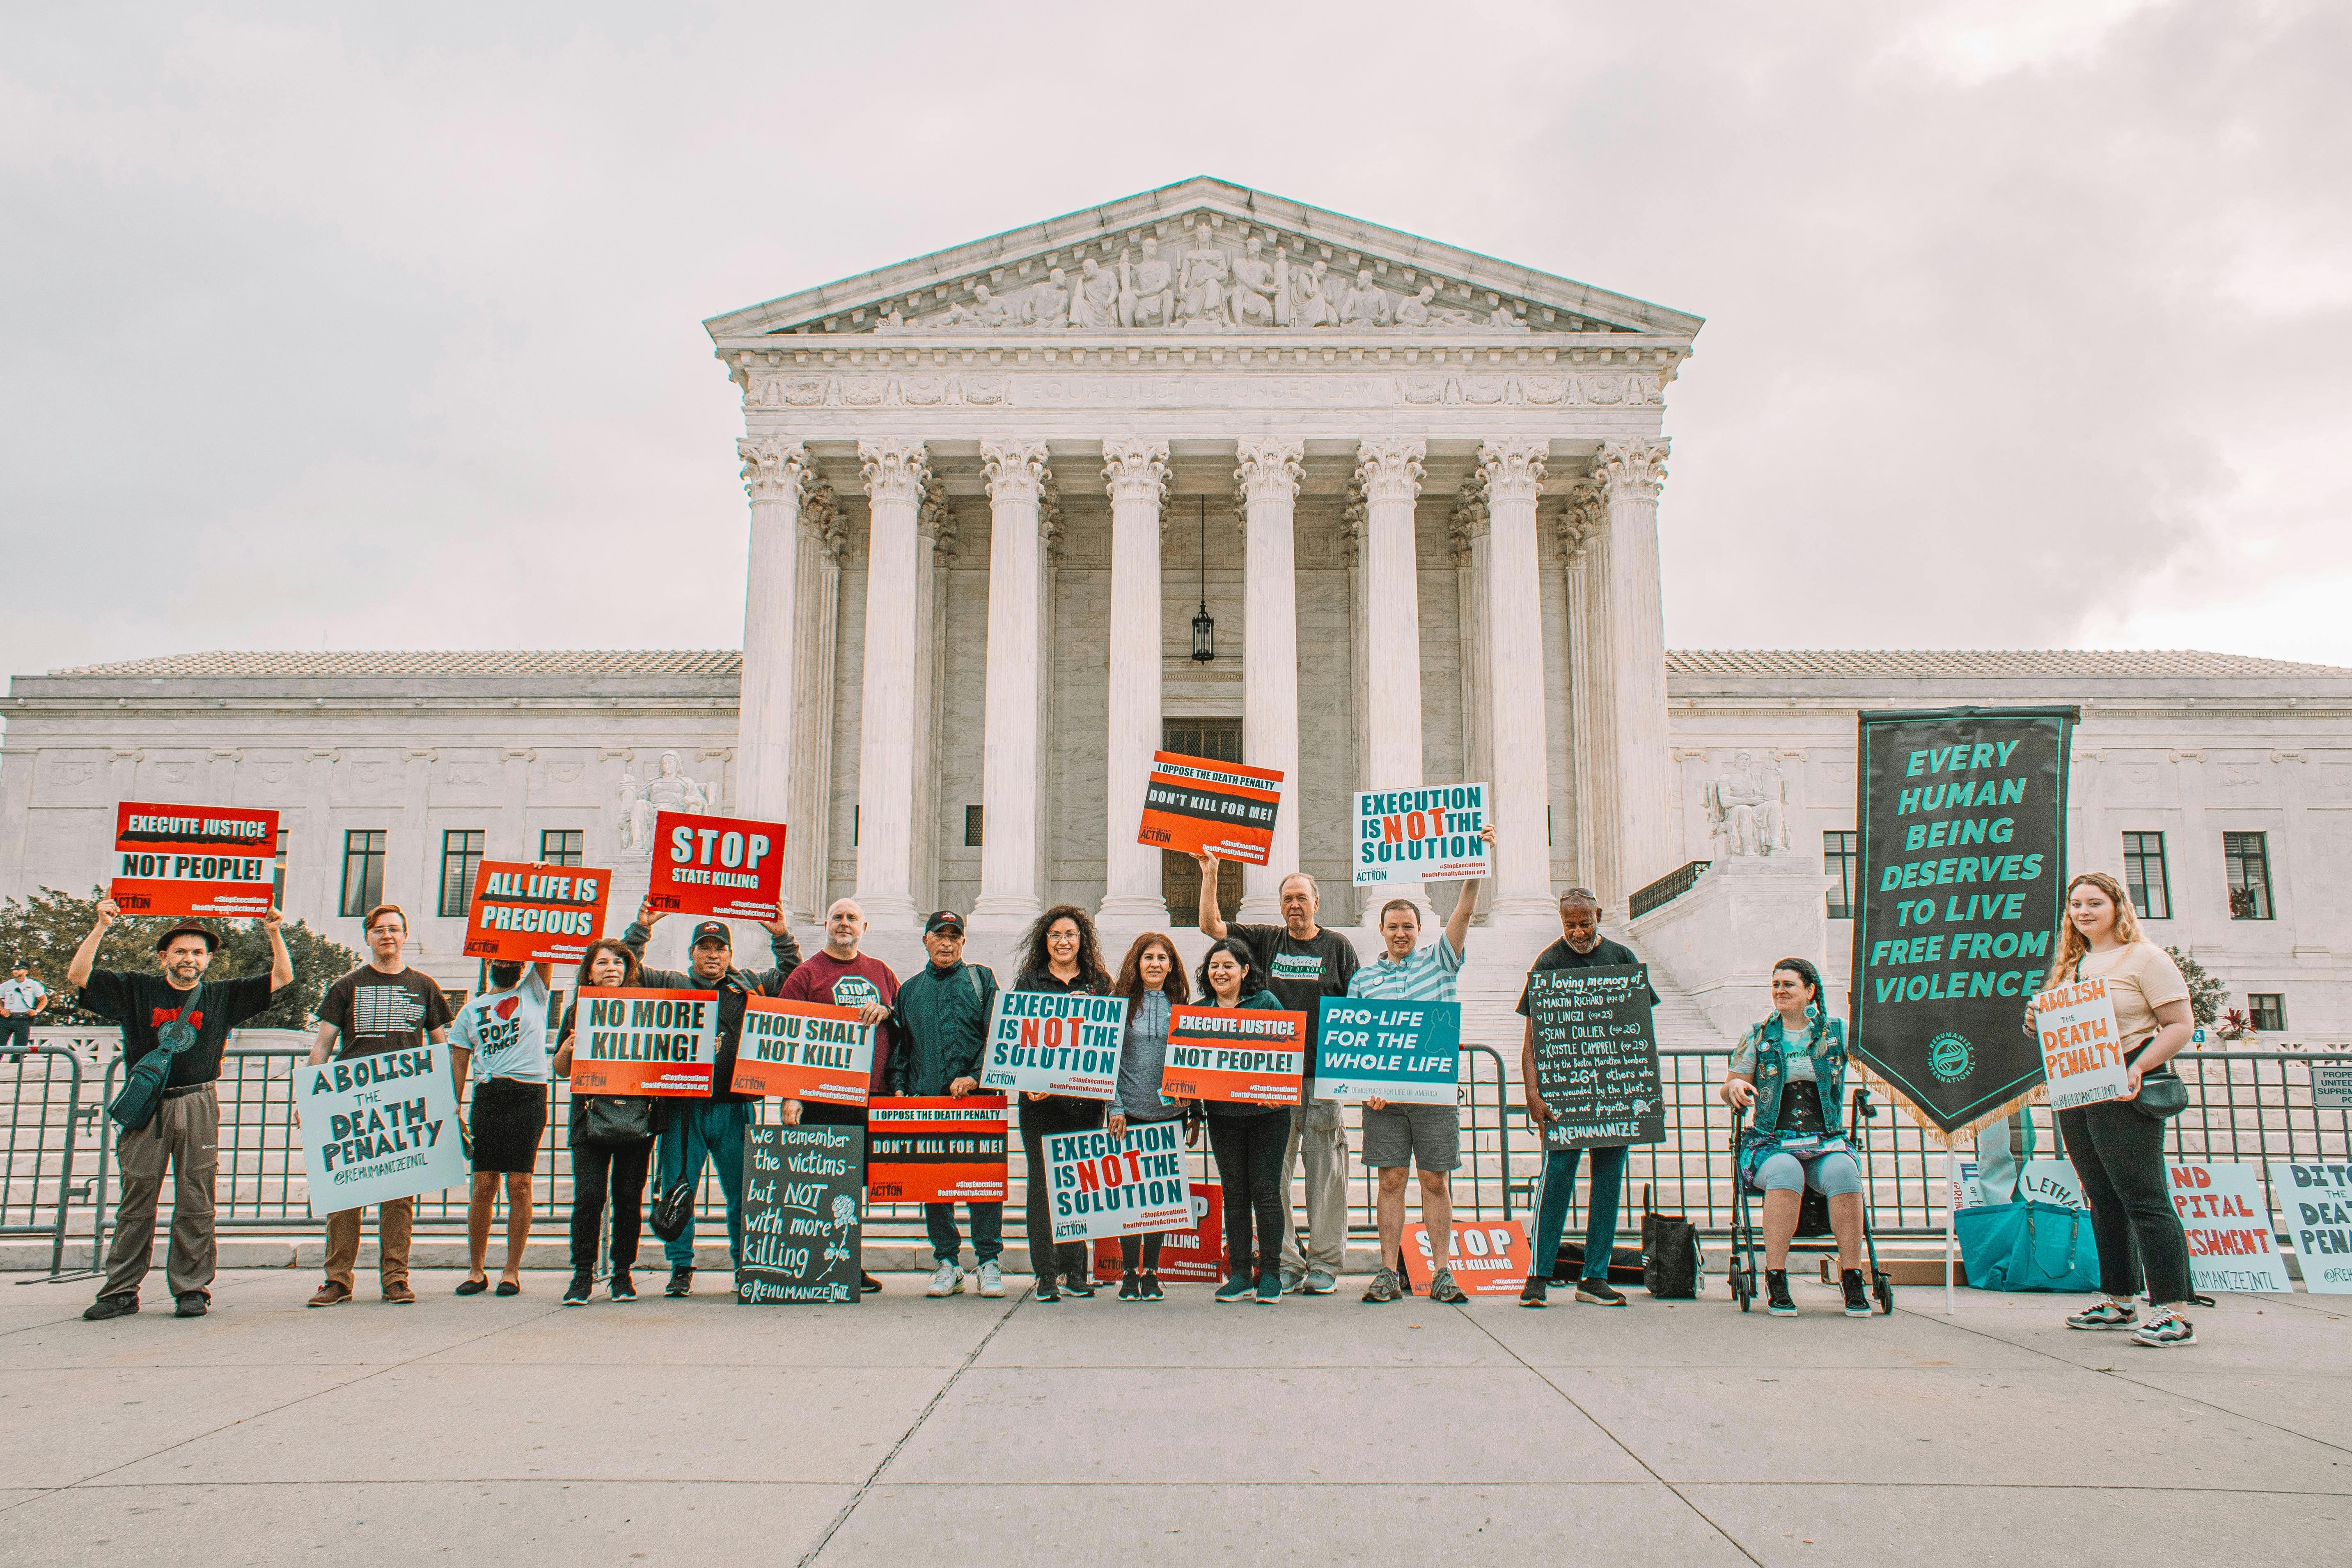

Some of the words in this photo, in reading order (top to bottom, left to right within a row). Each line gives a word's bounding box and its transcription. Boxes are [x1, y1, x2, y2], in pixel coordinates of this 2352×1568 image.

[1032, 381, 1119, 399] EQUAL
[1121, 380, 1220, 400] JUSTICE
[1235, 380, 1314, 399] UNDER
[1327, 381, 1375, 399] LAW
[1906, 740, 2020, 777] EVERY
[1162, 764, 1194, 777] OPPOSE
[1196, 770, 1210, 779] THE
[1213, 773, 1238, 784] DEATH
[1240, 777, 1275, 790] PENALTY
[1149, 789, 1187, 806] DON'T
[1190, 796, 1216, 812] KILL
[1221, 802, 1245, 816] FOR
[1249, 806, 1272, 821] ME!
[1362, 787, 1481, 816] EXECUTION
[1898, 778, 2027, 816] HUMAN
[129, 815, 200, 834] EXECUTE
[202, 819, 266, 838] JUSTICE
[1362, 819, 1380, 839] IS
[1383, 808, 1445, 844] NOT
[1445, 812, 1482, 832] THE
[1905, 817, 2014, 851] BEING
[671, 826, 770, 869] STOP
[1202, 844, 1264, 860] DeathPenaltyAction.org
[1221, 840, 1265, 852] #StopExecutions
[1362, 835, 1482, 863] SOLUTION
[123, 854, 171, 878] NOT
[174, 856, 263, 881] PEOPLE!
[672, 868, 711, 885] STATE
[712, 871, 759, 889] KILLING
[1422, 869, 1485, 878] DeathPenaltyAction.org
[1880, 854, 2044, 892] DESERVES
[485, 872, 523, 896] ALL
[527, 875, 571, 900] LIFE
[573, 878, 598, 901] IS
[481, 905, 593, 935] PRECIOUS
[1896, 898, 1936, 927] TO
[1944, 893, 2027, 922] LIVE
[1870, 935, 1944, 966] FREE
[1949, 931, 2049, 960] FROM
[839, 983, 871, 995] STOP
[1532, 974, 1547, 989] In
[1552, 972, 1584, 994] loving
[1587, 976, 1628, 988] memory
[1630, 971, 1643, 984] of
[1875, 970, 2045, 1004] VIOLENCE
[838, 995, 877, 1004] EXECUTIONS
[1002, 993, 1122, 1023] EXECUTION
[1543, 998, 1571, 1008] MARTIN
[1574, 995, 1603, 1007] RICHARD
[1606, 995, 1617, 1003] (age
[1618, 993, 1625, 1002] 8)
[2038, 979, 2106, 1014] ABOLISH
[475, 1005, 493, 1027] I
[590, 999, 626, 1027] NO
[631, 1000, 706, 1029] MORE
[1179, 1015, 1237, 1033] EXECUTE
[1239, 1019, 1295, 1036] JUSTICE
[1326, 1008, 1424, 1027] PRO-LIFE
[1543, 1011, 1553, 1024] LU
[1557, 1011, 1584, 1023] LINGZI
[1588, 1011, 1600, 1020] (age
[1601, 1009, 1613, 1019] 23)
[2060, 1014, 2075, 1024] THE
[477, 1017, 521, 1044] POPE
[746, 1012, 802, 1038] THOU
[805, 1019, 870, 1045] SHALT
[997, 1018, 1019, 1040] IS
[1020, 1017, 1084, 1048] NOT
[1083, 1025, 1119, 1048] THE
[1324, 1030, 1369, 1047] FOR
[1377, 1032, 1418, 1049] THE
[1545, 1027, 1565, 1041] SEAN
[1572, 1025, 1605, 1039] COLLIER
[1609, 1025, 1622, 1036] (age
[1622, 1022, 1640, 1034] 26)
[1929, 1032, 1974, 1048] REHUMANIZE
[2043, 1018, 2108, 1052] DEATH
[590, 1032, 699, 1062] KILLING!
[757, 1038, 800, 1063] NOT
[802, 1043, 853, 1069] KILL!
[994, 1042, 1116, 1075] SOLUTION
[1173, 1047, 1213, 1068] NOT
[1216, 1050, 1293, 1072] PEOPLE!
[1545, 1043, 1577, 1058] KRYSTLE
[1581, 1041, 1618, 1055] CAMPBELL
[1621, 1040, 1631, 1052] (age
[1632, 1038, 1648, 1051] 29)
[312, 1049, 433, 1096] ABOLISH
[1325, 1052, 1402, 1071] WHOLE
[1407, 1056, 1453, 1073] LIFE
[1554, 1060, 1560, 1071] by
[1561, 1059, 1571, 1068] the
[1573, 1057, 1592, 1068] Boston
[1928, 1059, 1975, 1083] INTERNATIONAL
[2044, 1040, 2120, 1080] PENALTY
[1068, 1076, 1114, 1086] #StopExecutions
[1541, 1072, 1550, 1084] &
[1553, 1072, 1567, 1082] the
[1569, 1068, 1599, 1084] 264
[1605, 1068, 1635, 1081] others
[1638, 1066, 1654, 1077] who
[353, 1090, 382, 1105] THE
[1050, 1083, 1113, 1094] DeathPenaltyAction.org
[1562, 1084, 1592, 1096] wounded
[1596, 1084, 1605, 1097] by
[1607, 1084, 1620, 1094] the
[1623, 1081, 1644, 1095] blast
[330, 1096, 428, 1142] DEATH
[876, 1110, 879, 1119] I
[882, 1110, 915, 1120] OPPOSE
[917, 1110, 933, 1120] THE
[934, 1110, 962, 1120] DEATH
[964, 1110, 1000, 1120] PENALTY
[1579, 1102, 1591, 1112] not
[1595, 1100, 1630, 1117] forgotten
[781, 1126, 850, 1149] remember
[1051, 1125, 1176, 1163] EXECUTION
[1548, 1121, 1640, 1145] #REHUMANIZE
[322, 1119, 444, 1173] PENALTY
[873, 1139, 913, 1153] DON'T
[917, 1139, 945, 1153] KILL
[949, 1139, 974, 1153] FOR
[979, 1139, 1004, 1153] ME!
[753, 1148, 780, 1171] the
[788, 1150, 857, 1177] victims-
[1054, 1165, 1076, 1190] IS
[1076, 1149, 1142, 1194] NOT
[1140, 1153, 1180, 1179] THE
[747, 1178, 777, 1204] but
[784, 1182, 829, 1208] NOT
[1057, 1178, 1183, 1217] SOLUTION
[2324, 1190, 2347, 1199] THE
[745, 1206, 784, 1235] with
[789, 1217, 832, 1238] more
[1123, 1216, 1188, 1229] DeathPenaltyAction.org
[1140, 1208, 1187, 1218] #StopExecutions
[742, 1235, 809, 1278] killing
[1466, 1258, 1513, 1270] KILLING
